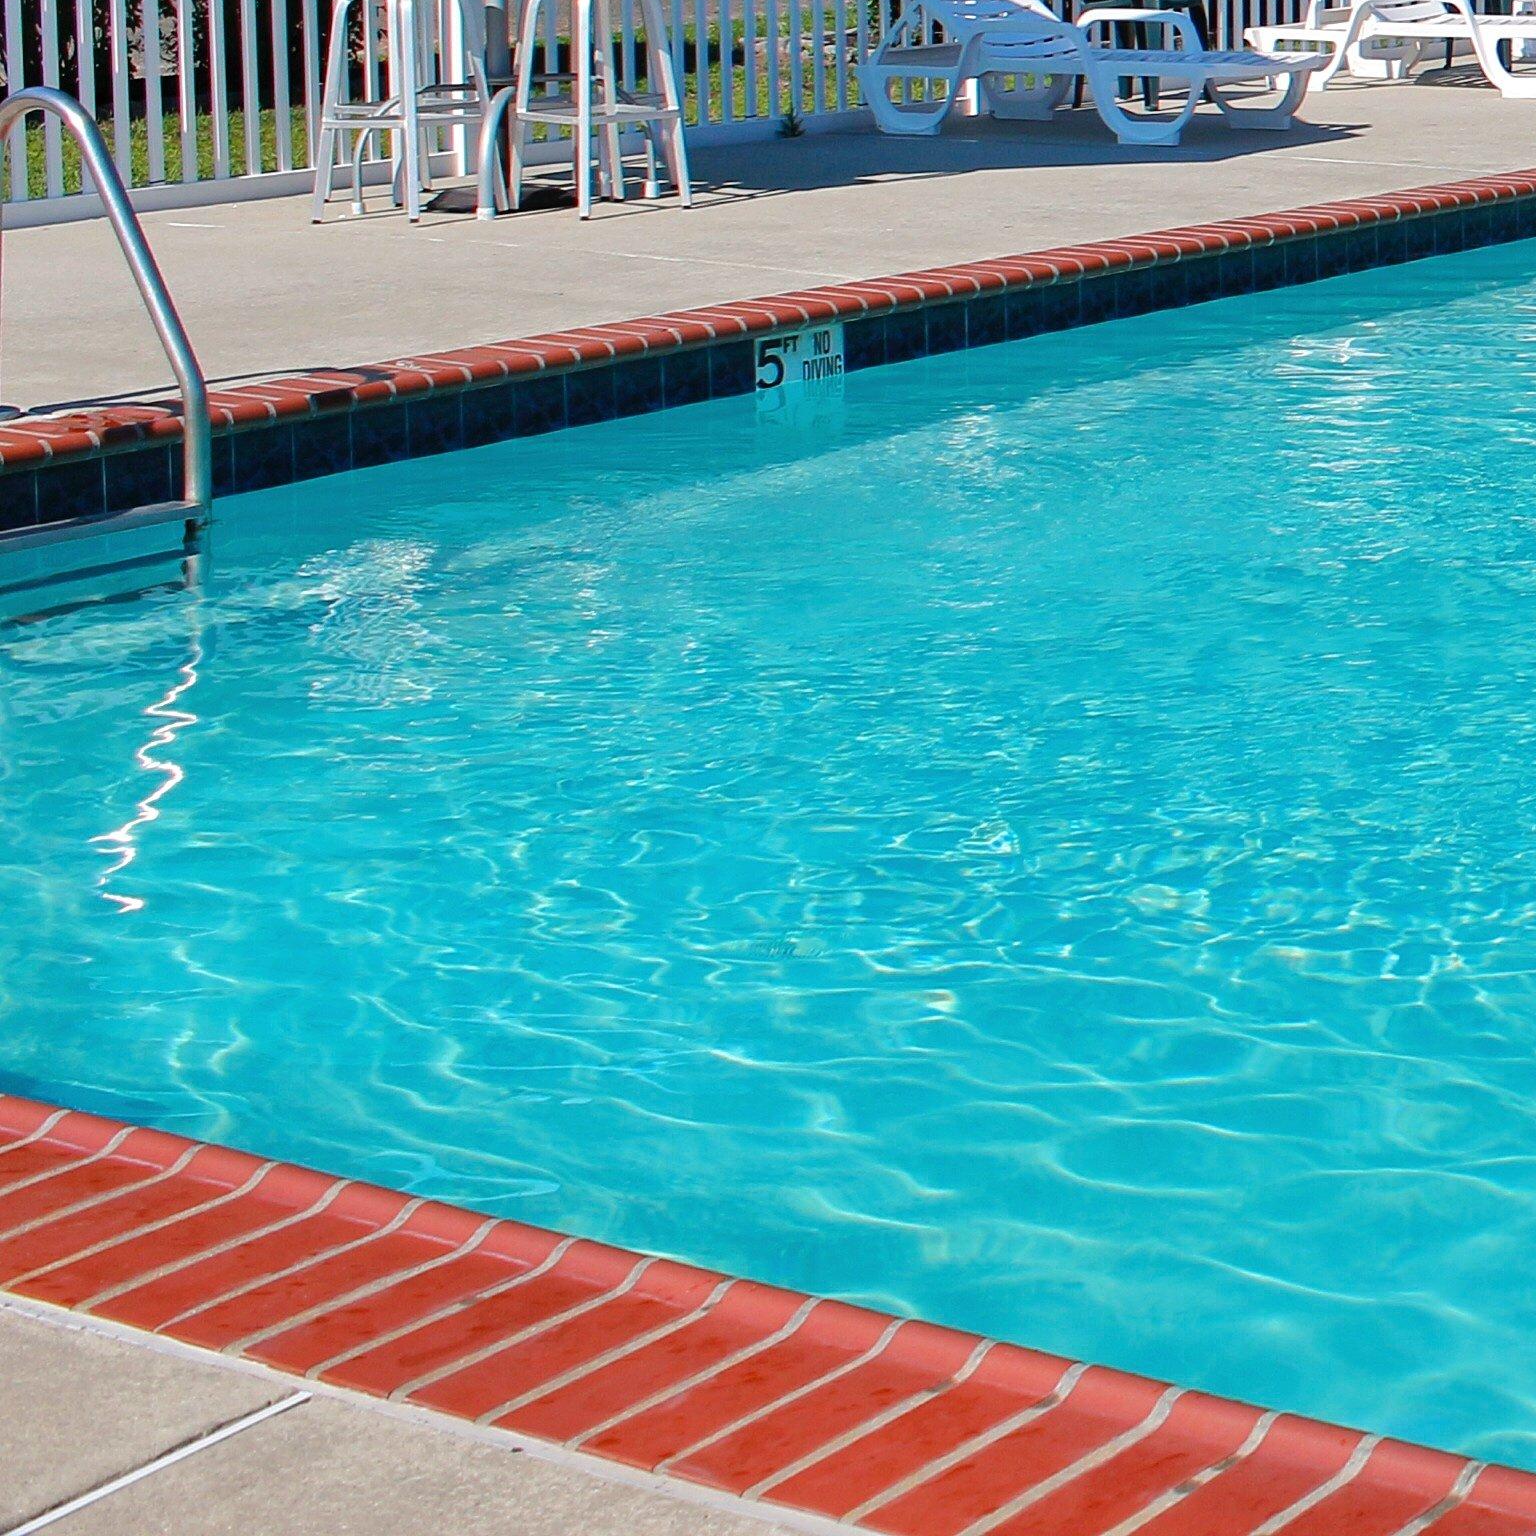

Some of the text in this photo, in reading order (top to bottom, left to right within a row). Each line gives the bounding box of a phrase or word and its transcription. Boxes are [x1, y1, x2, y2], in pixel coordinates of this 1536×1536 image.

[813, 330, 831, 356] NO
[757, 335, 800, 389] 5 FT
[802, 354, 843, 381] DIVING
